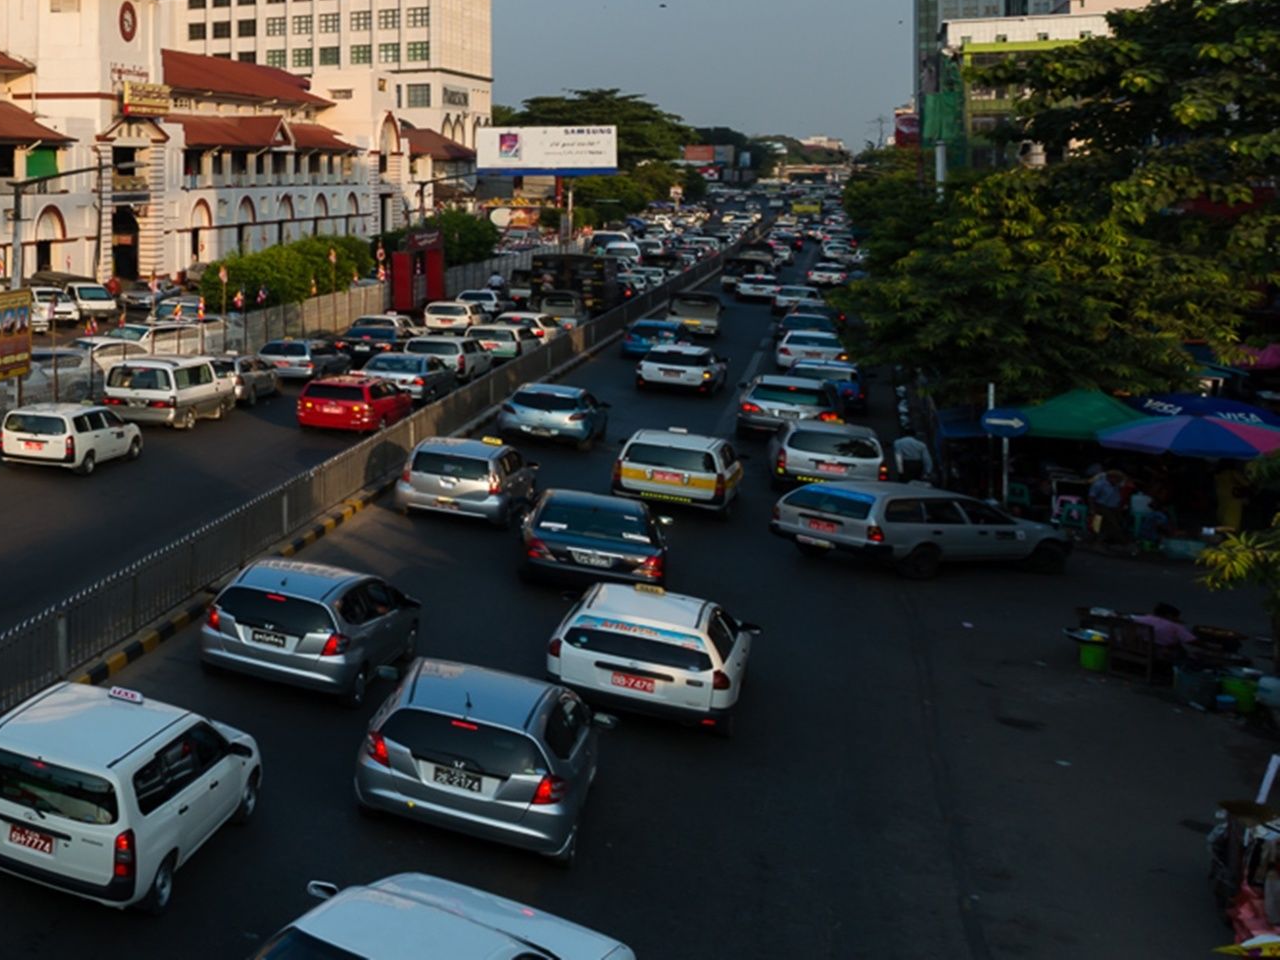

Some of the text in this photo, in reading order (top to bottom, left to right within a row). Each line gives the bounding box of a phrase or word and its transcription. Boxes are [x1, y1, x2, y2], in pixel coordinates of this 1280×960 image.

[564, 128, 613, 136] SAMSUNG
[1143, 398, 1183, 416] VISA
[1217, 411, 1264, 424] VISA
